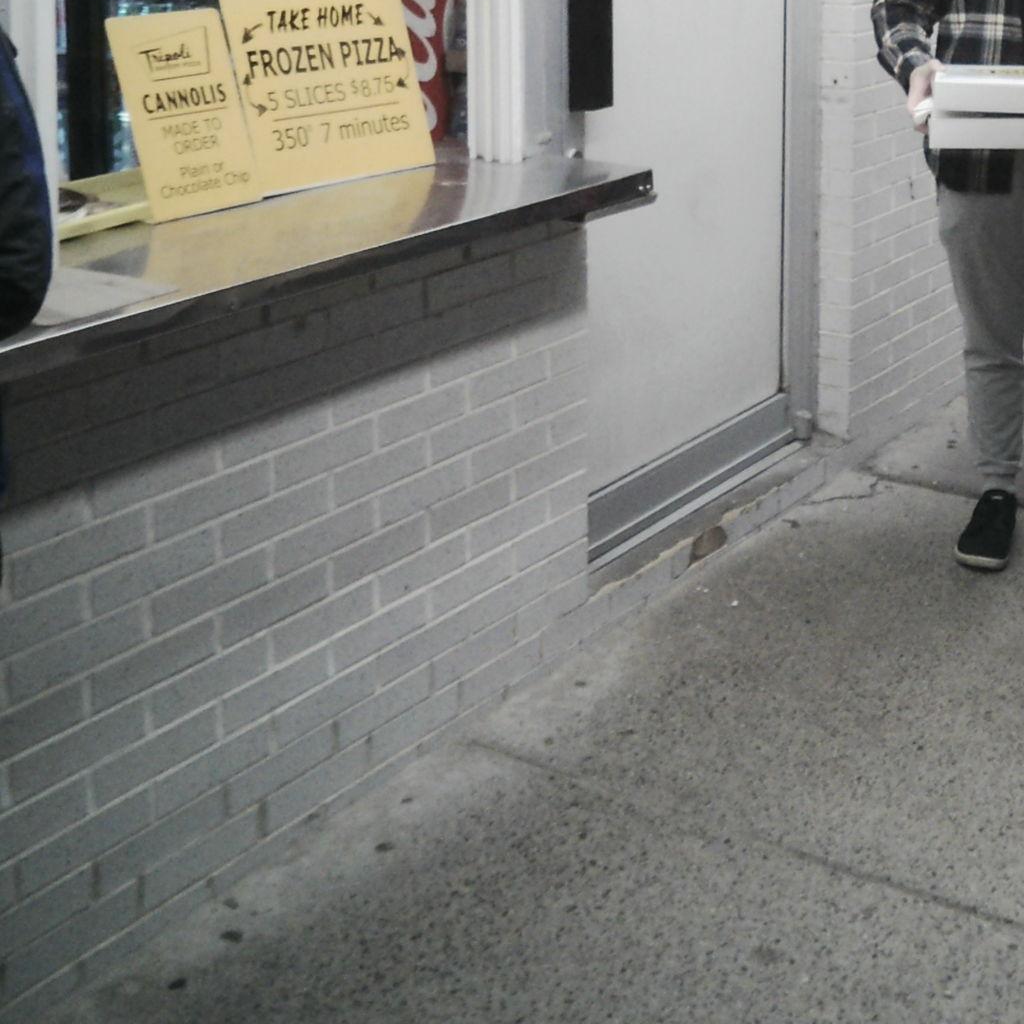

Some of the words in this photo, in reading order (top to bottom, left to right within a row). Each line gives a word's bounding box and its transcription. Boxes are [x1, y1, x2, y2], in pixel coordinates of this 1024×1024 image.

[267, 7, 311, 33] TAKE
[317, 3, 364, 28] HOME
[246, 42, 335, 79] FROZEN
[339, 36, 400, 68] PIZZA
[143, 83, 227, 114] CANNOLIS
[267, 91, 279, 111] 5
[284, 82, 346, 109] SLICES
[351, 75, 395, 98] $8.75
[161, 120, 200, 139] MADE
[202, 117, 222, 131] TO
[321, 122, 331, 143] 7
[339, 114, 410, 141] minutes
